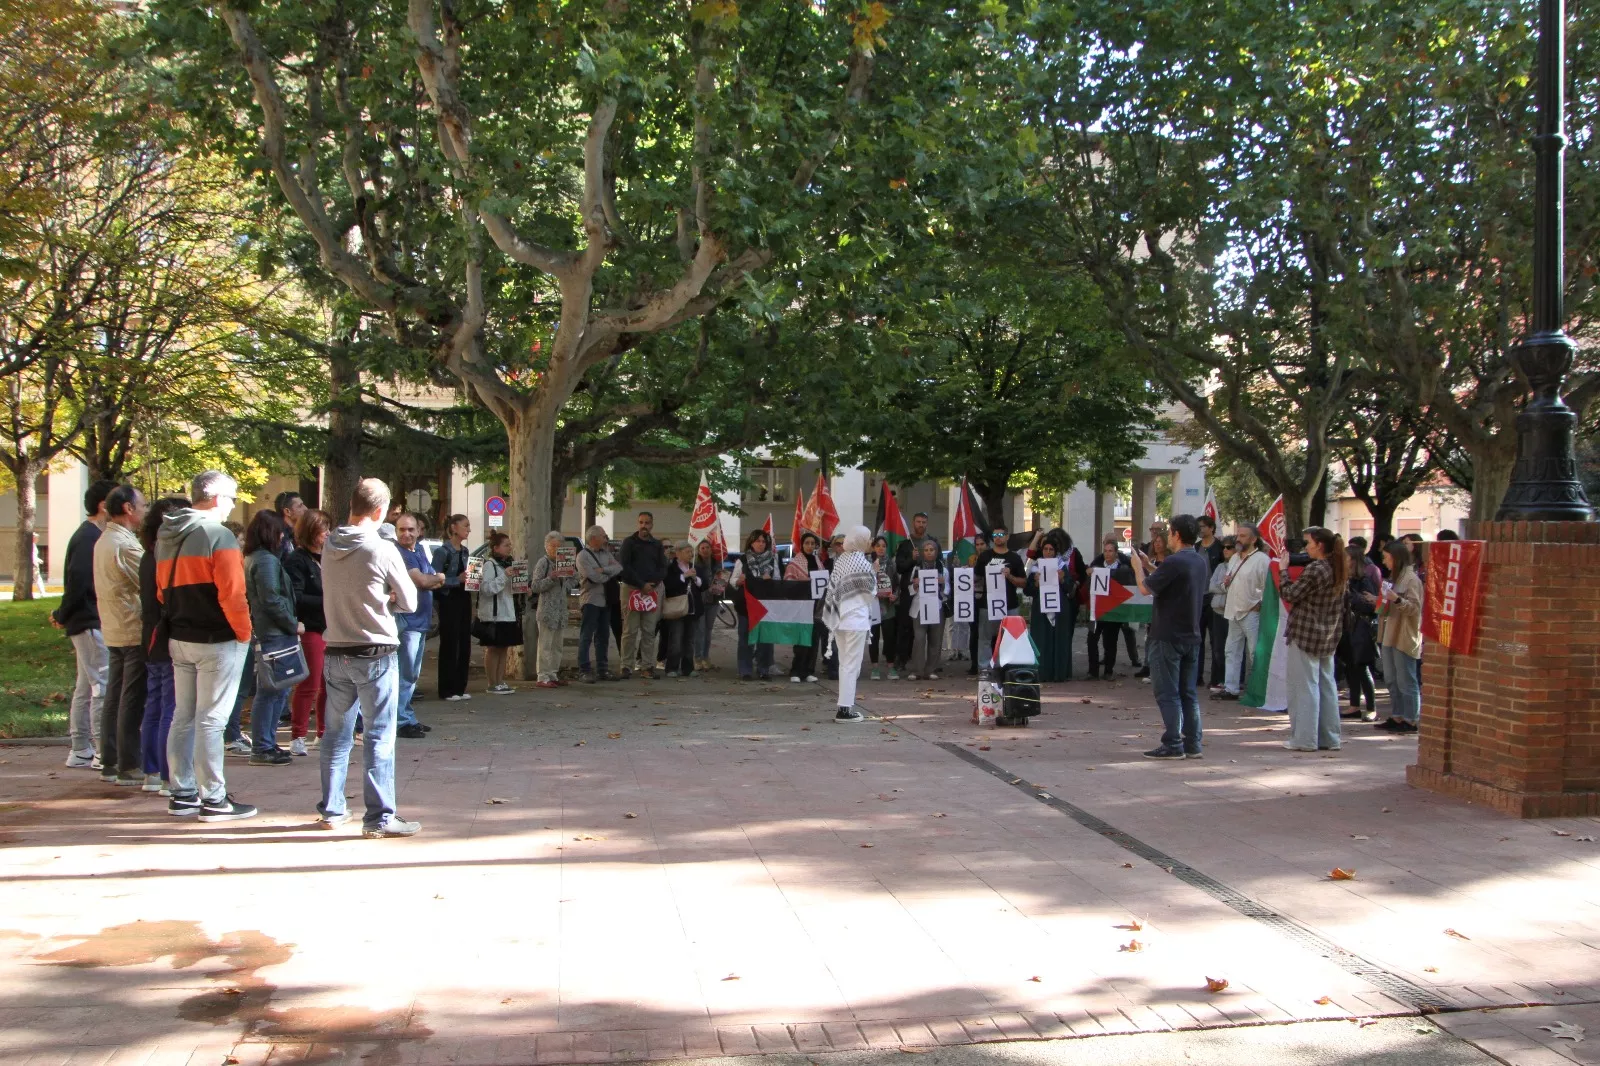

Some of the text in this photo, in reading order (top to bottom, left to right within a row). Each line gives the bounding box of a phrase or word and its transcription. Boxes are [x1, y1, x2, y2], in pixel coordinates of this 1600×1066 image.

[815, 577, 828, 595] P
[923, 576, 936, 593] E
[957, 574, 971, 591] S
[989, 572, 1002, 589] T
[1094, 575, 1108, 592] N
[1443, 543, 1461, 617] CCOO
[991, 599, 1006, 617] R
[1044, 592, 1057, 609] E
[958, 601, 971, 618] B
